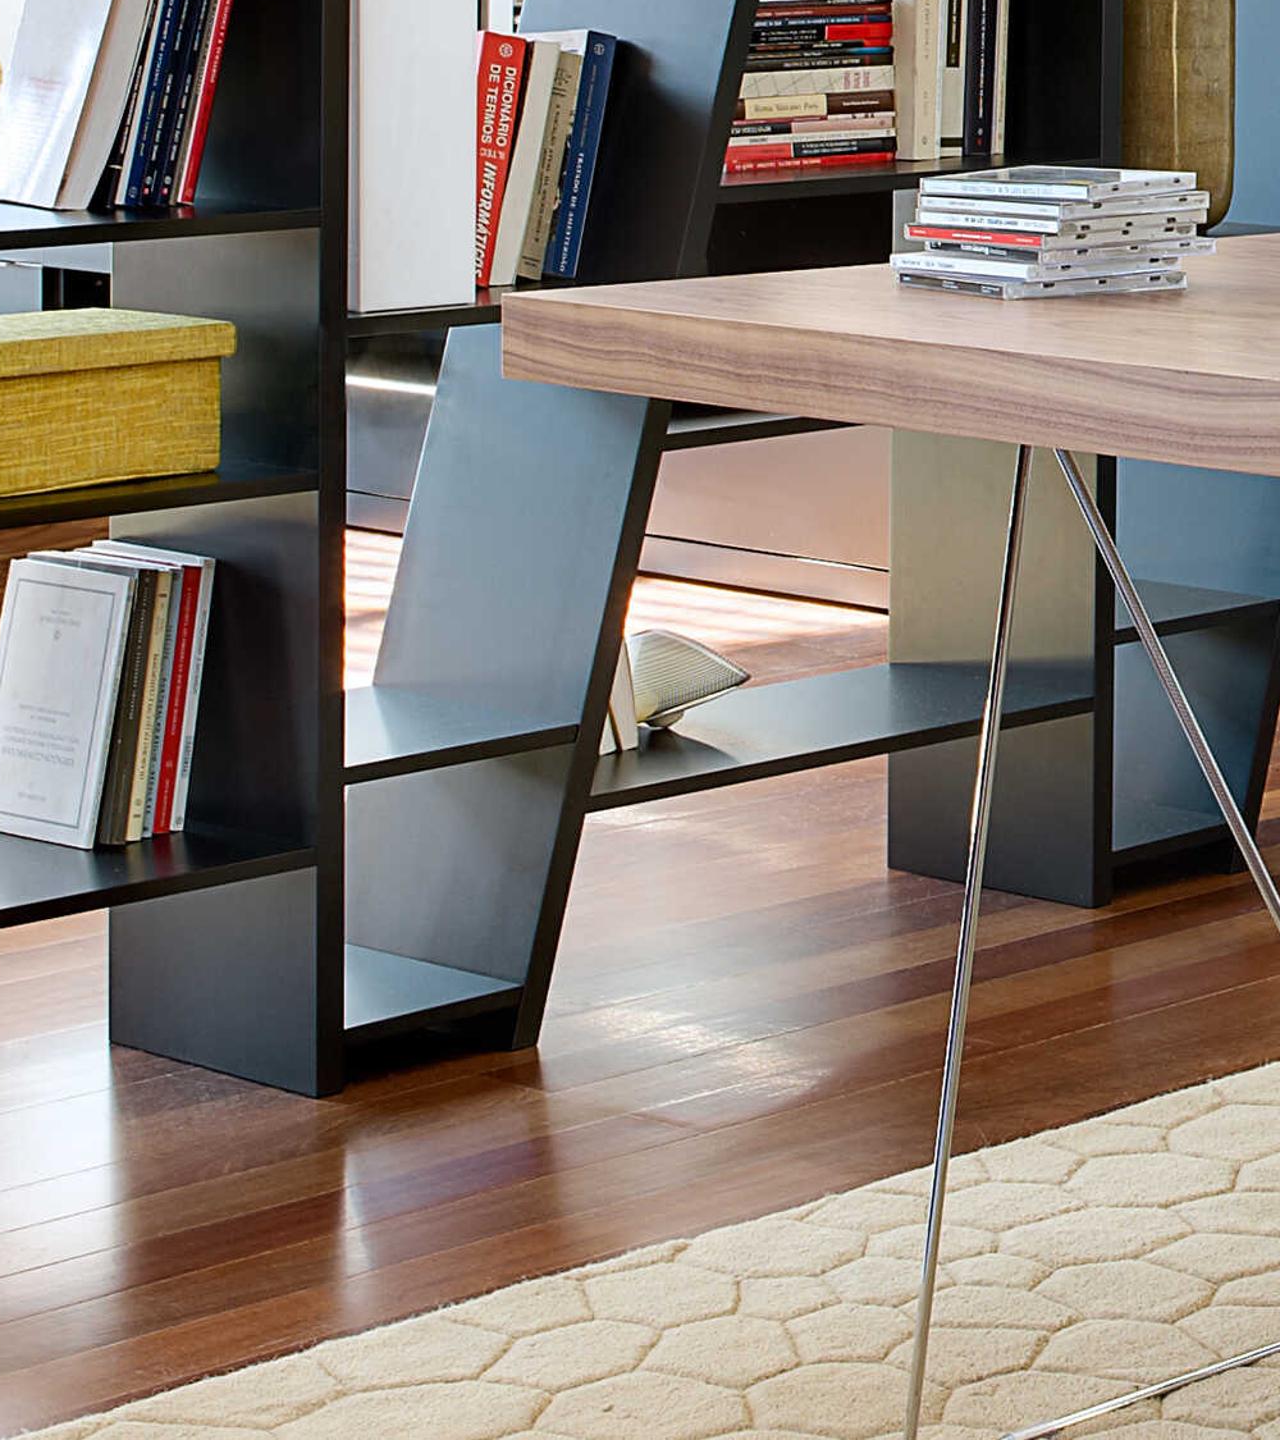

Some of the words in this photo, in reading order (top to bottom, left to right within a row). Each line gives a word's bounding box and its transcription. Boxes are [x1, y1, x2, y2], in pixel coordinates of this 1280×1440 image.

[488, 63, 501, 83] DE
[481, 86, 499, 144] TERMOS
[496, 66, 517, 148] DICIONÁRIO
